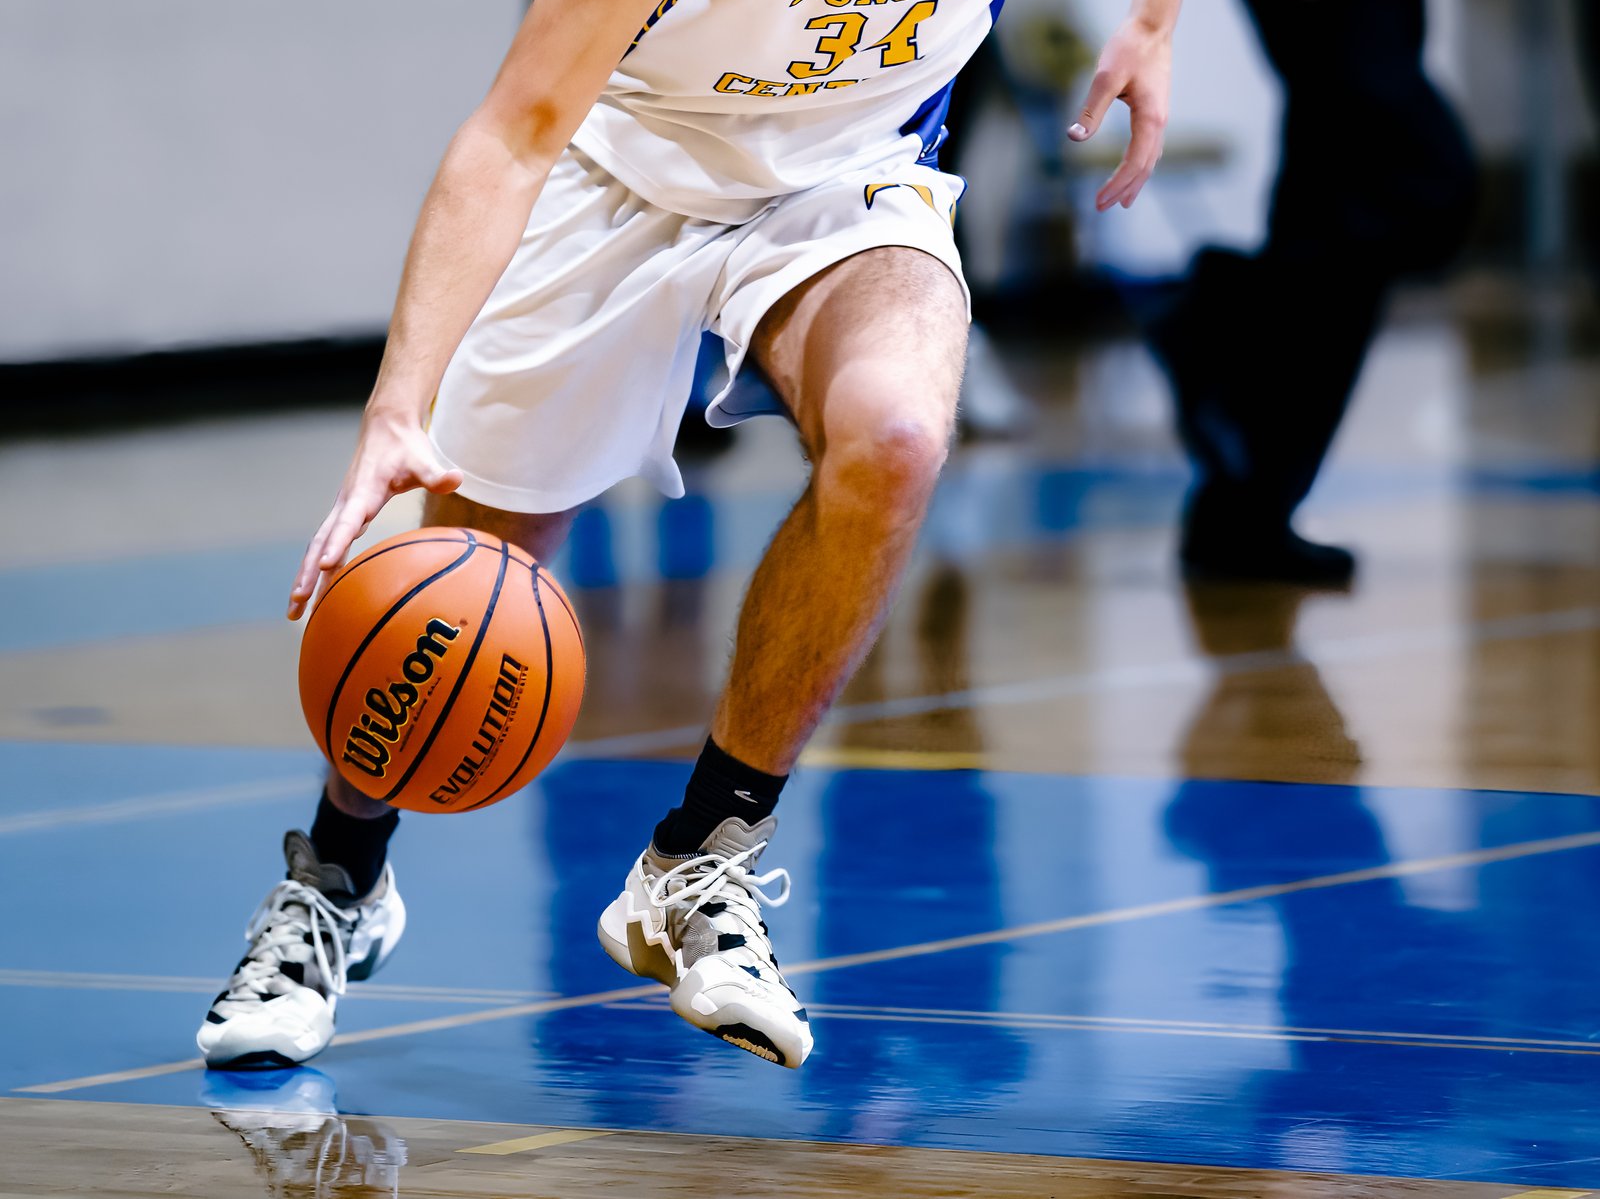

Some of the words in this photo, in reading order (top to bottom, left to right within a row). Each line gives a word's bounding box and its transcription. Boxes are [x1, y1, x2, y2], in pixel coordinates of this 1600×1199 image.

[787, 0, 938, 79] 34
[342, 617, 460, 778] Wilson
[429, 653, 522, 804] EVOLUTION
